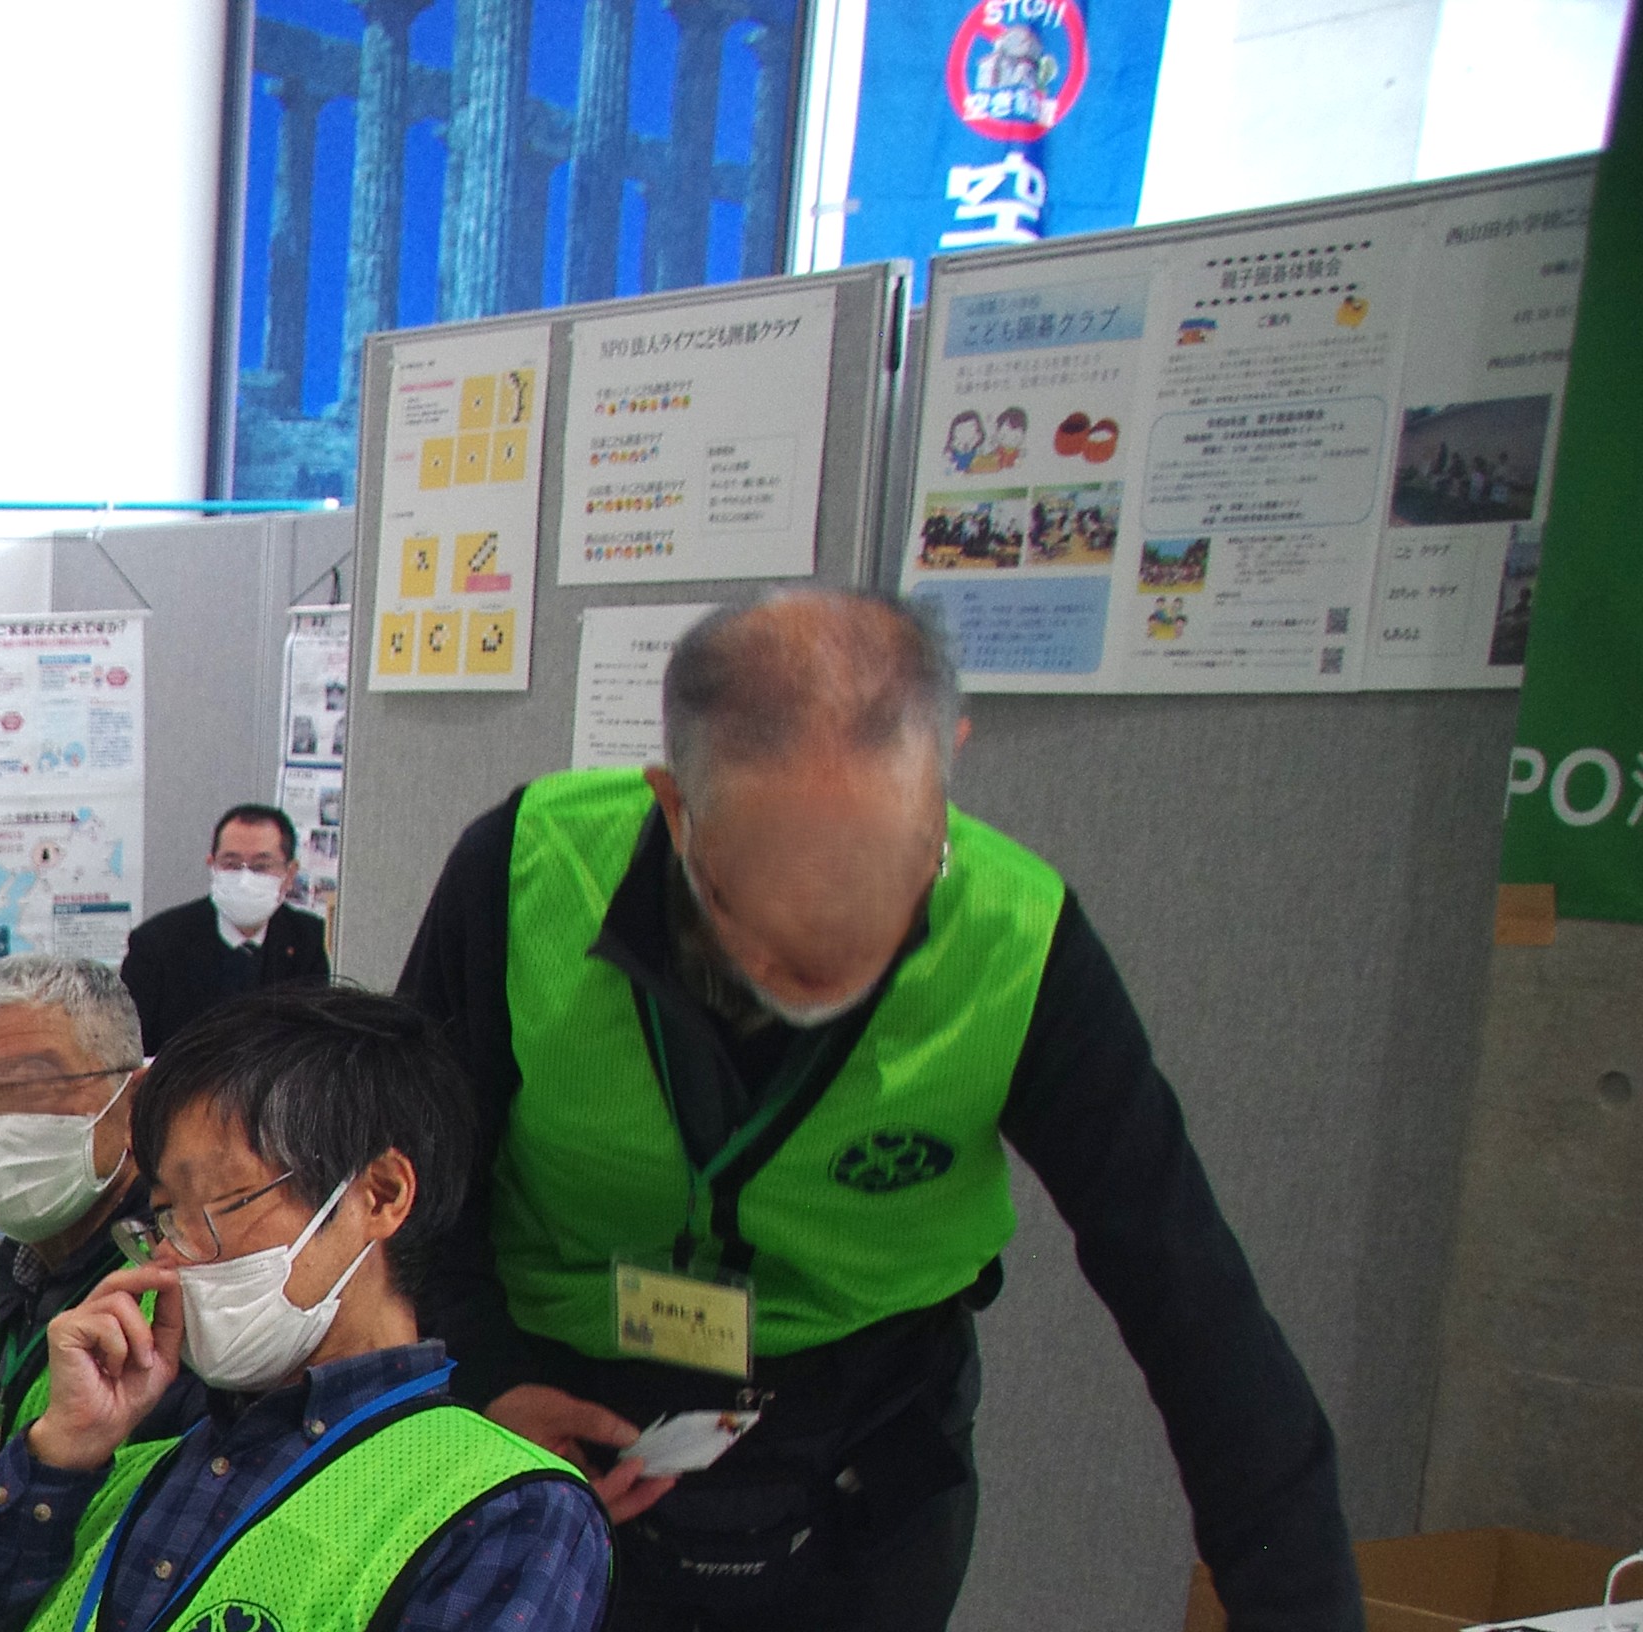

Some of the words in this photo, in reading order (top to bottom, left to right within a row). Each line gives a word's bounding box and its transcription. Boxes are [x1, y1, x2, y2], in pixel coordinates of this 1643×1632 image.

[940, 151, 1046, 248] 空
[964, 303, 1120, 349] こども囲碁クラブ
[1503, 748, 1643, 827] PO
